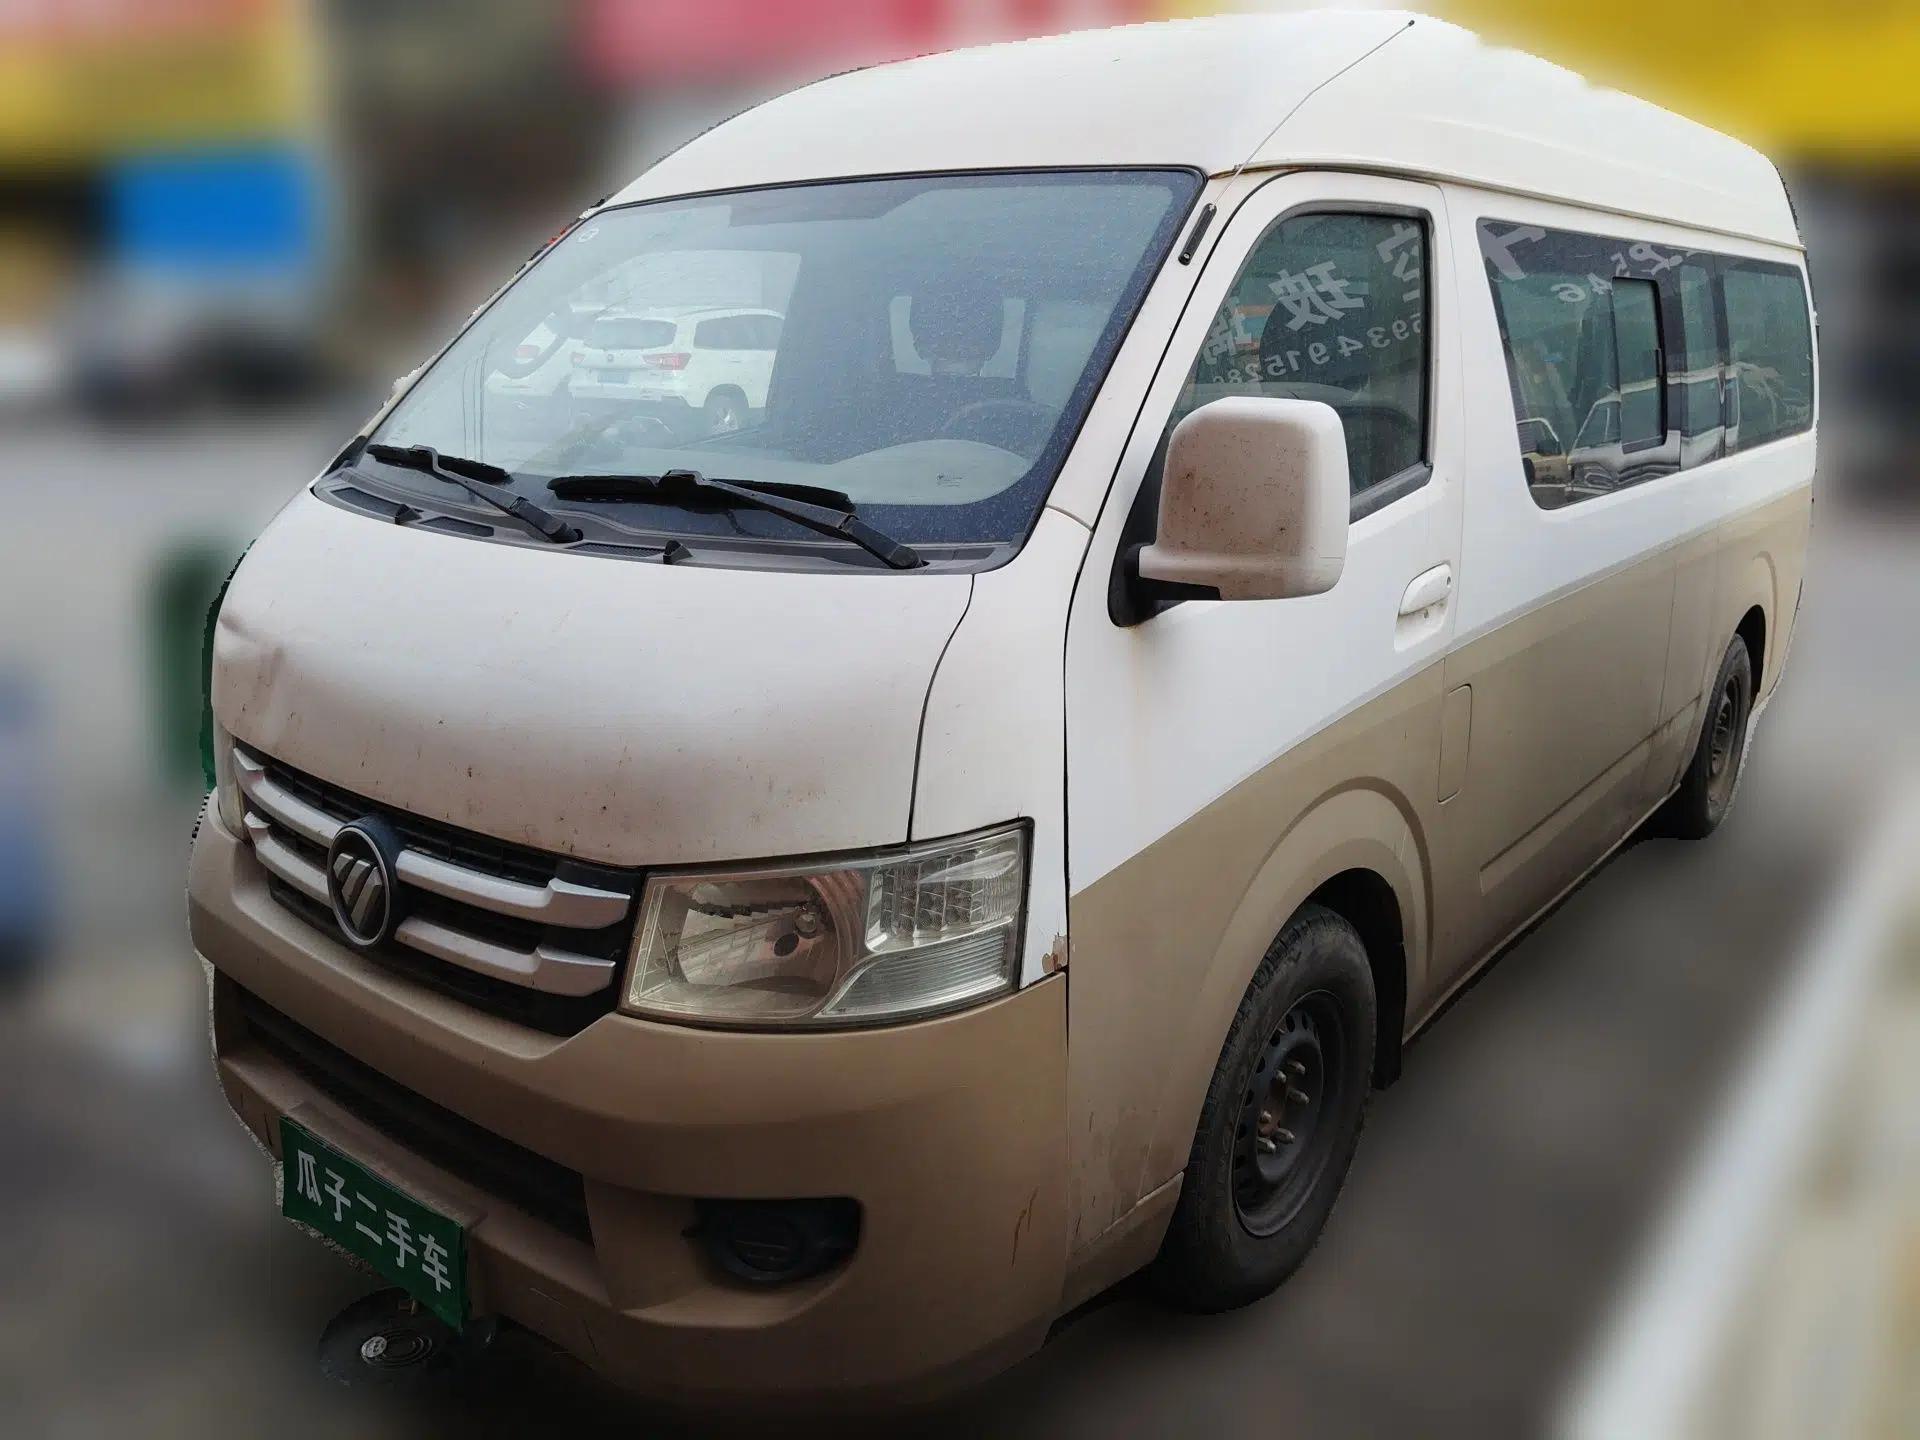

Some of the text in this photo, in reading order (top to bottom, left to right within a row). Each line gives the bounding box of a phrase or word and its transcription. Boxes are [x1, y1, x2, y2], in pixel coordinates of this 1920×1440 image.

[297, 1148, 452, 1292] 瓜子二手车
